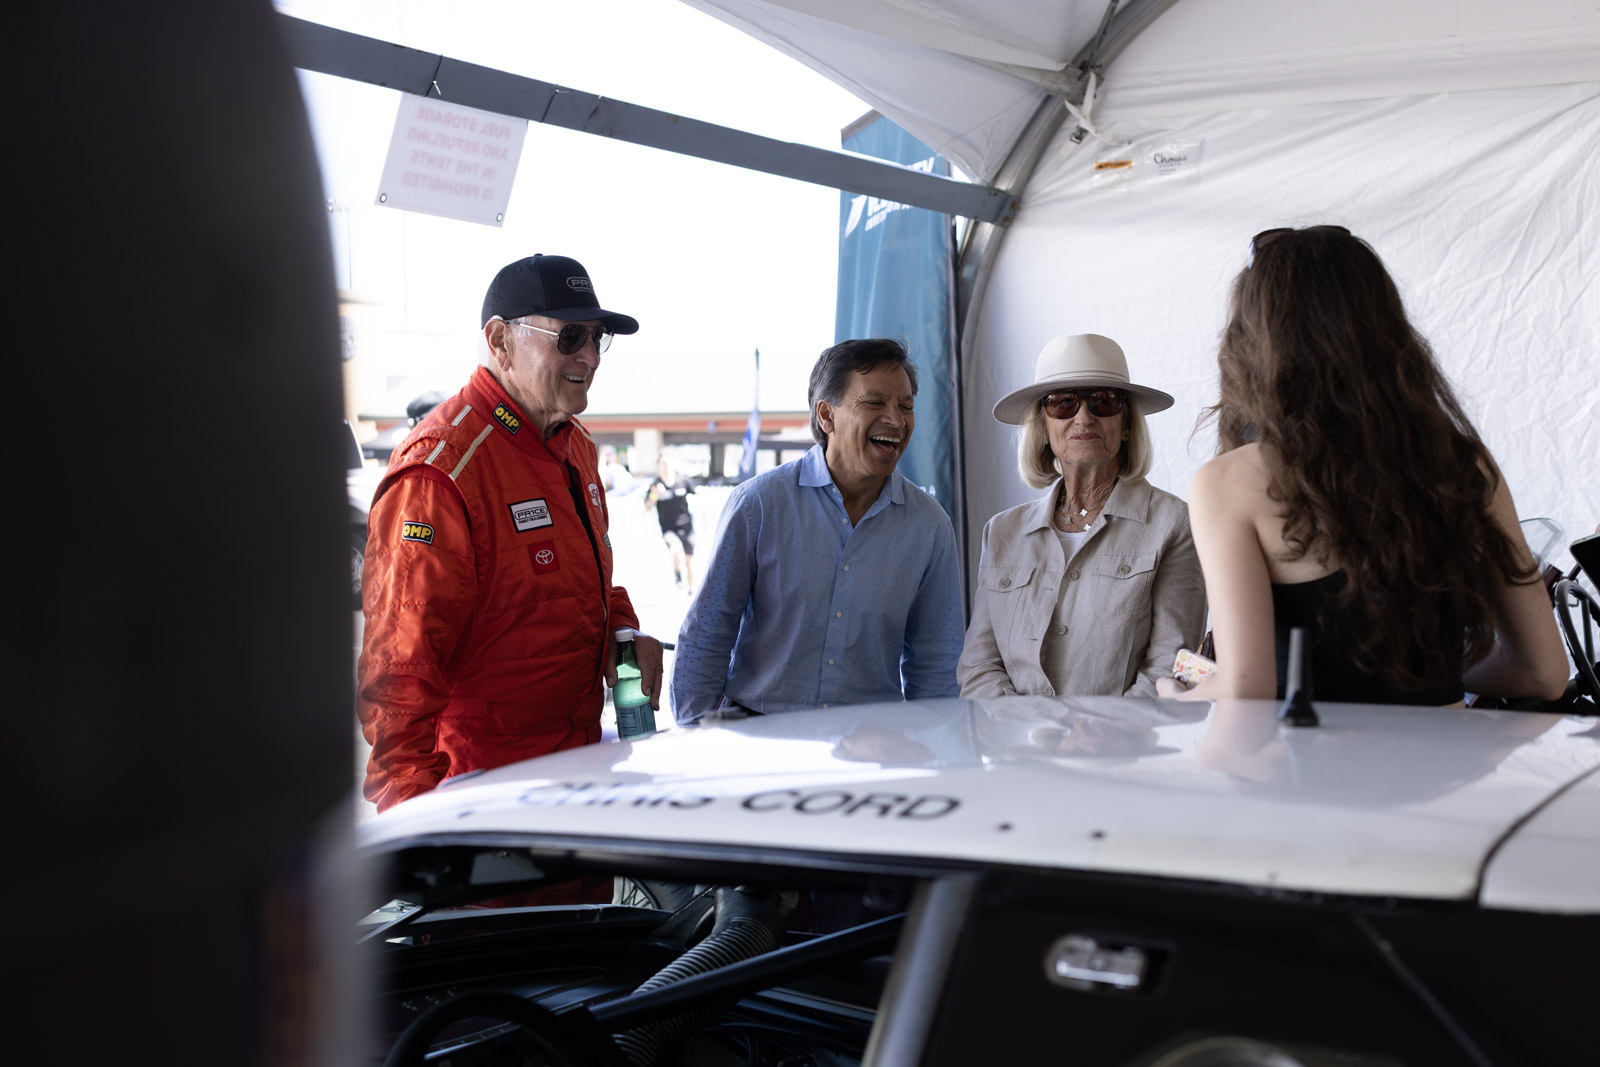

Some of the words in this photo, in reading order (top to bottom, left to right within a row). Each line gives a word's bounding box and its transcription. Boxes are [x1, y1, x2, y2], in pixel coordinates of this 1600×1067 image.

[495, 405, 520, 428] OMP
[403, 524, 432, 539] OMP
[740, 788, 961, 821] CORD
